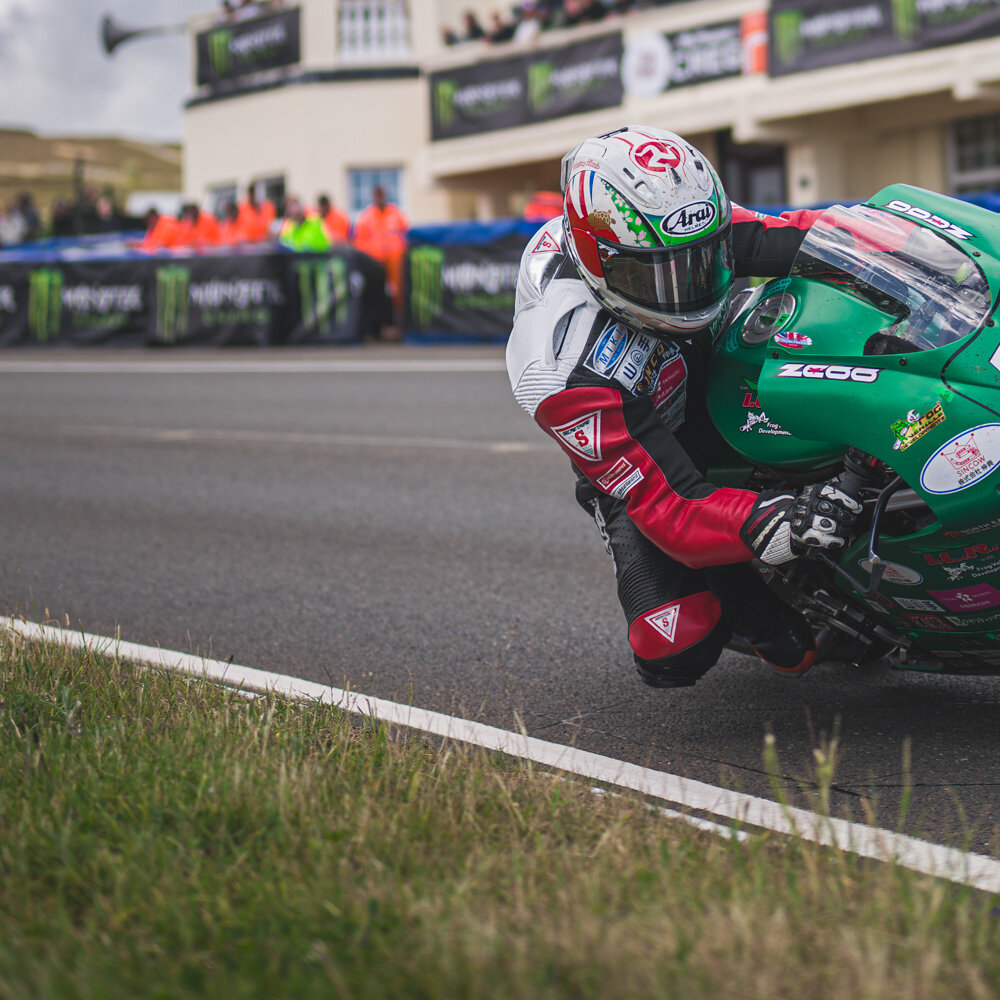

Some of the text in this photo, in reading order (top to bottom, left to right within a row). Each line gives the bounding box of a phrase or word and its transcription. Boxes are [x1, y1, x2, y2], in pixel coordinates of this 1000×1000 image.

[667, 202, 712, 233] Arai
[599, 328, 625, 366] MIKI
[574, 429, 590, 448] S
[957, 455, 986, 477] SINCOW
